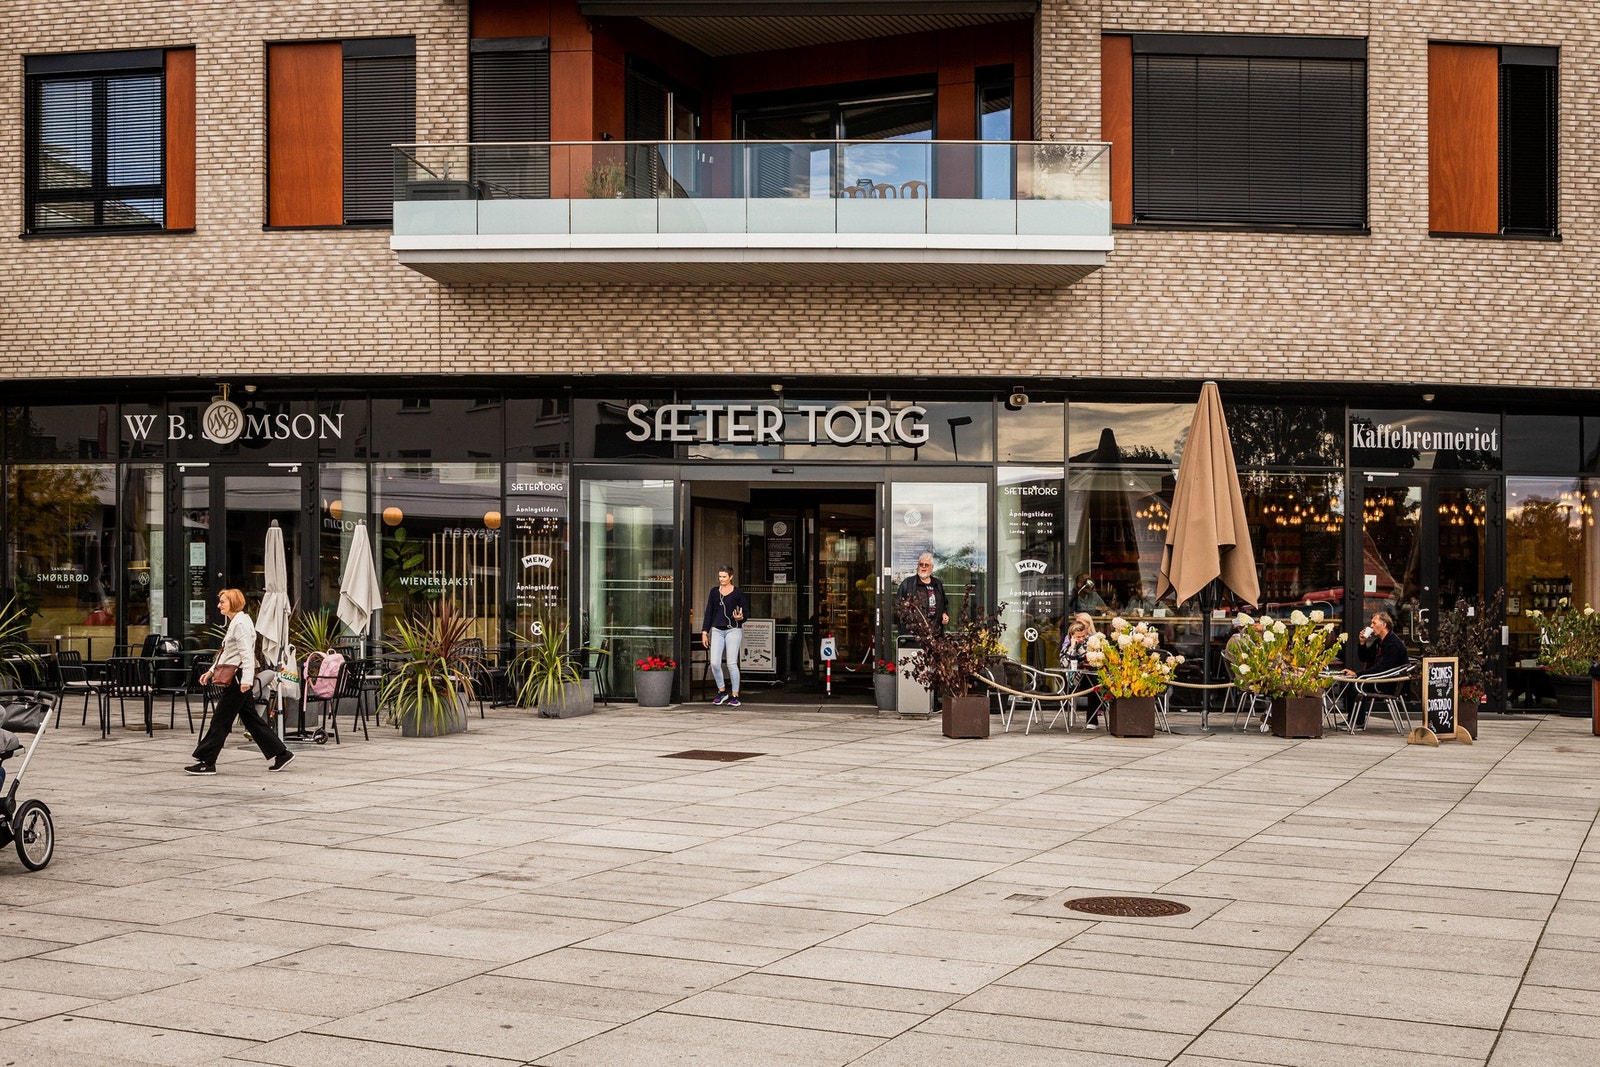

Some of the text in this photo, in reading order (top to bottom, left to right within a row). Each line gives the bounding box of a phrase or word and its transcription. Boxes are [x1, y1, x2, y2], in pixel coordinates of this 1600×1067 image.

[167, 414, 194, 440] B.
[202, 413, 344, 441] MSON
[625, 404, 930, 444] SÆTER TORG
[1352, 423, 1498, 451] Kaffebrenneriet
[526, 556, 549, 564] MENY
[1019, 562, 1044, 570] MENY
[37, 573, 89, 583] SMØRBRØD
[399, 576, 475, 586] WIENERBAKST
[516, 582, 559, 591] Åpningstider:
